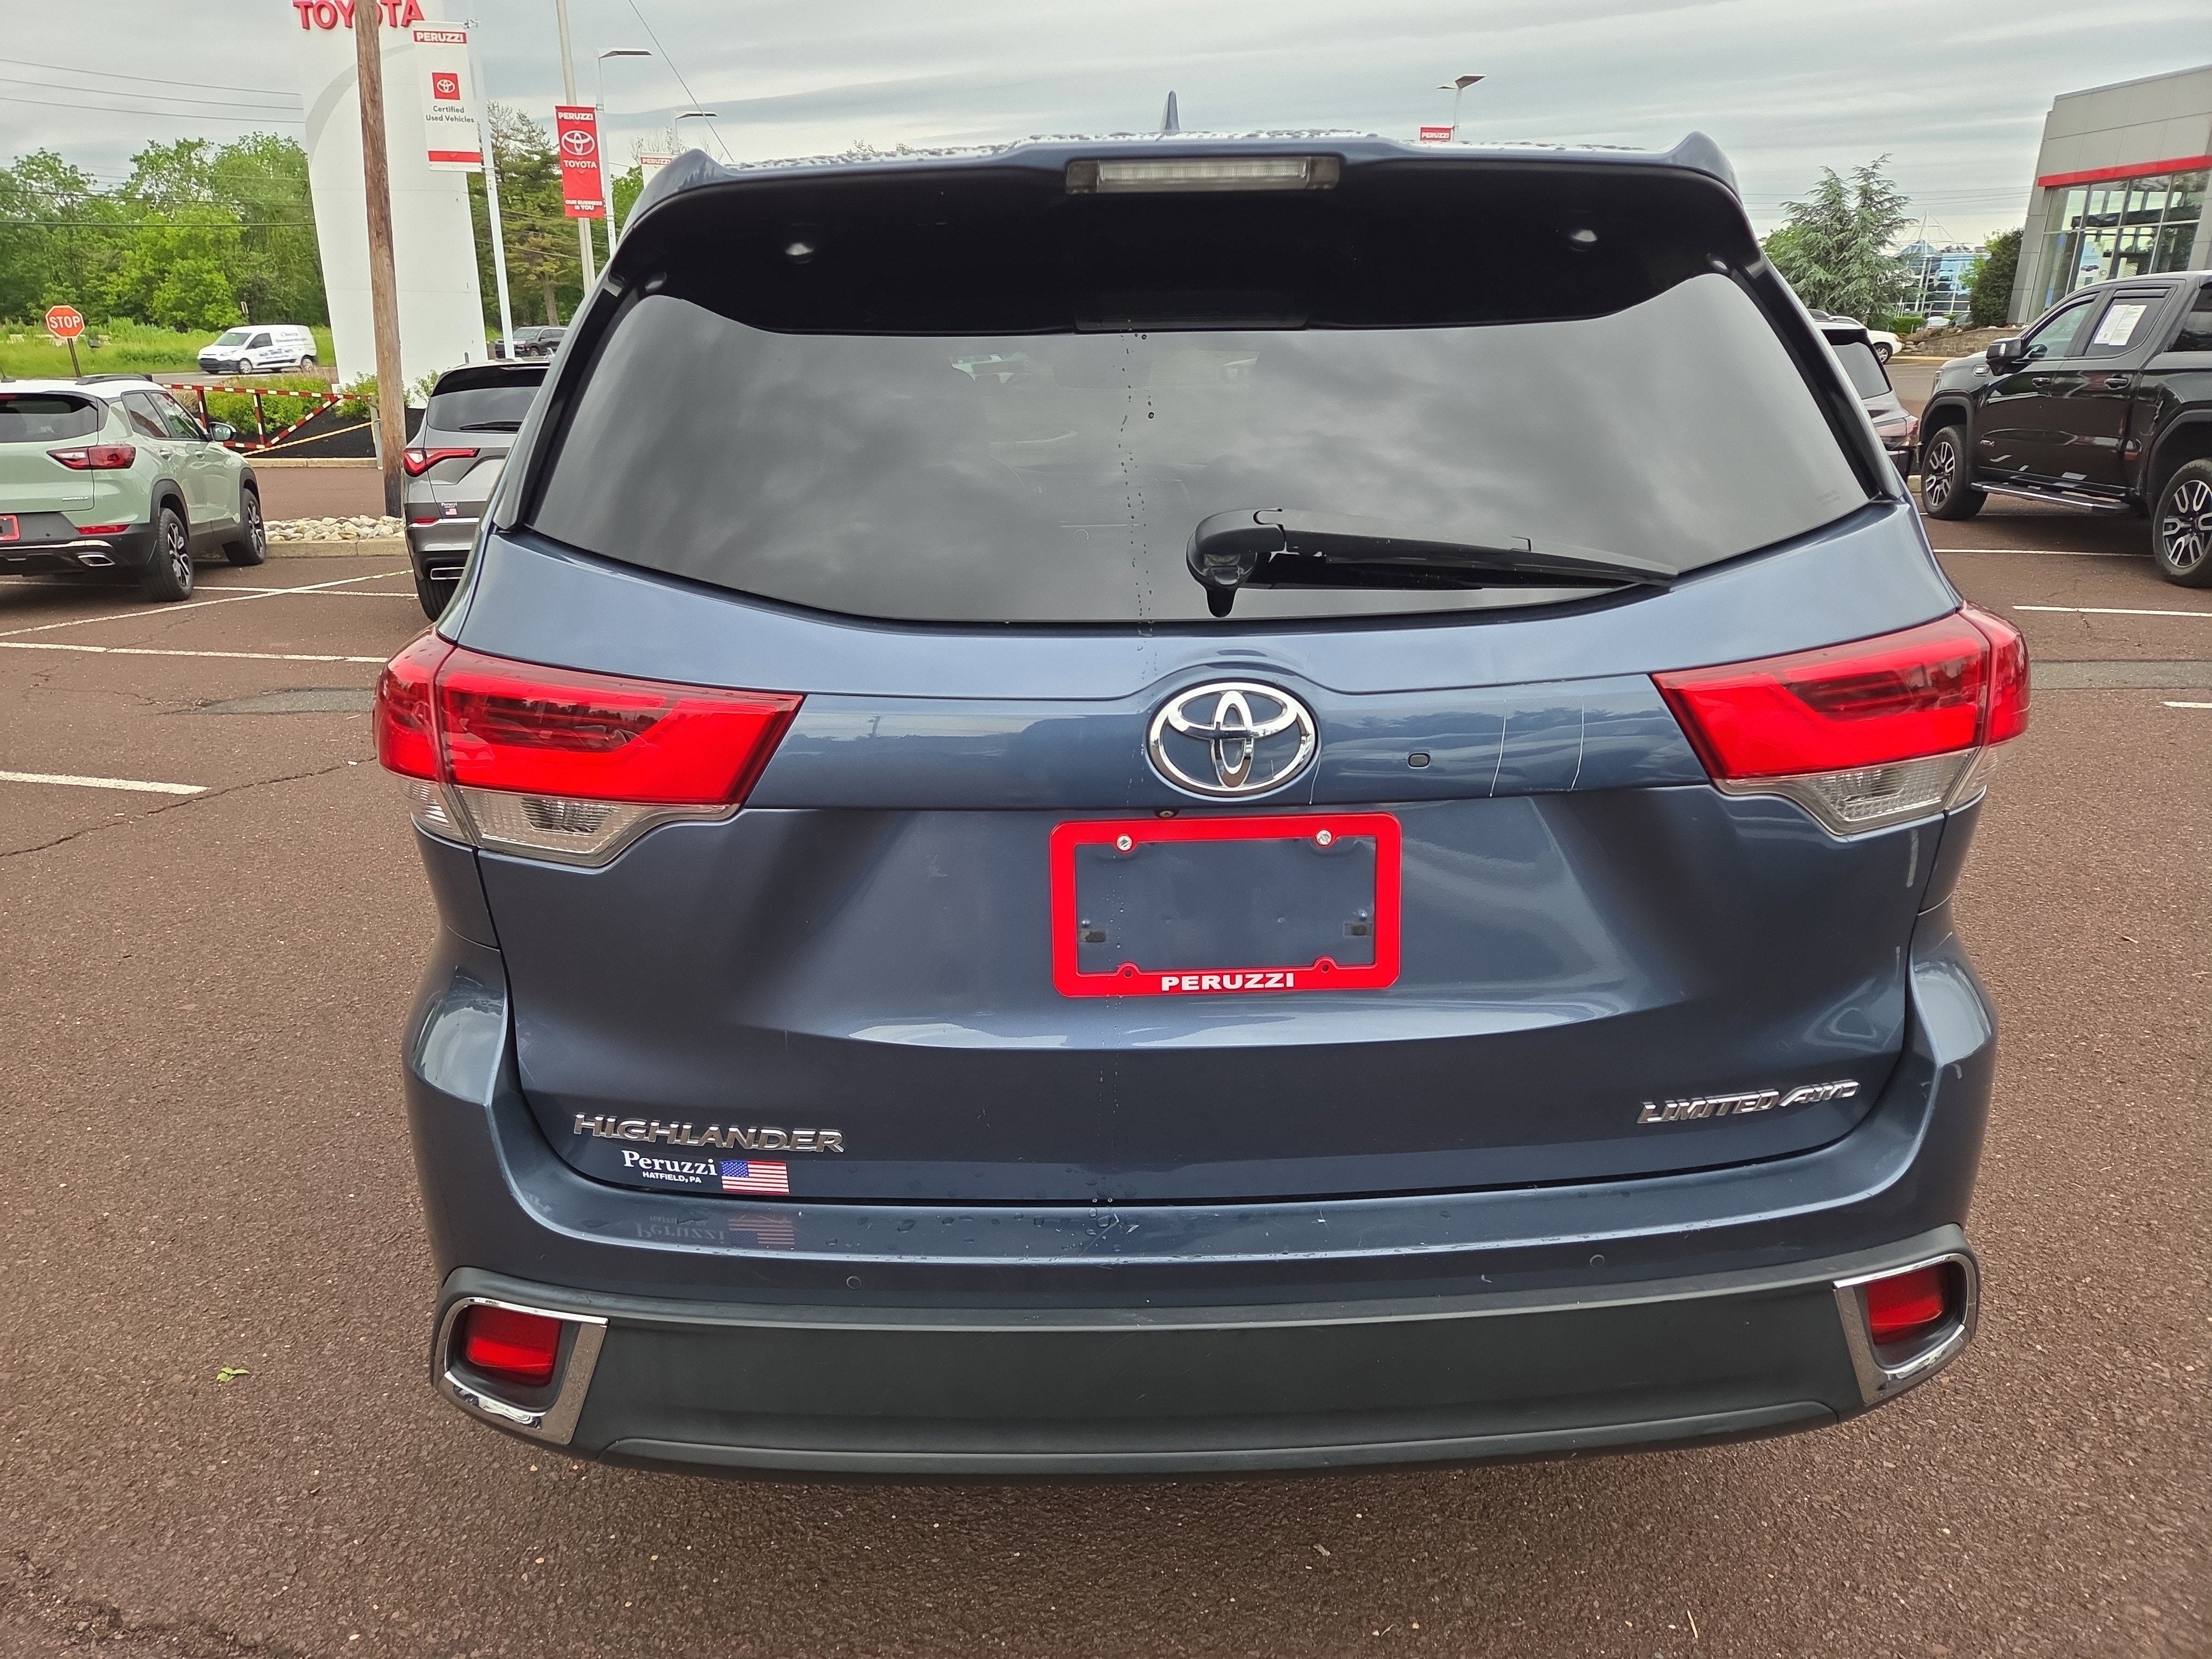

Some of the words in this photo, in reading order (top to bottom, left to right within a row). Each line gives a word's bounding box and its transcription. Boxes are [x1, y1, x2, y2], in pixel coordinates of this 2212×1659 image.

[293, 0, 425, 29] TOYTA
[416, 31, 463, 42] PERUZZI
[433, 105, 465, 113] Certified
[558, 112, 594, 120] PERUZZI
[563, 160, 597, 169] TOYOTA
[49, 316, 81, 329] STOP
[1161, 973, 1294, 992] PERUZZI
[1636, 1088, 1780, 1124] LIMITED
[1779, 1079, 1861, 1107] AWD
[573, 1112, 845, 1153] HIGHLANDER
[621, 1150, 718, 1176] Peruzzi
[642, 1171, 689, 1183] HATFIELD,
